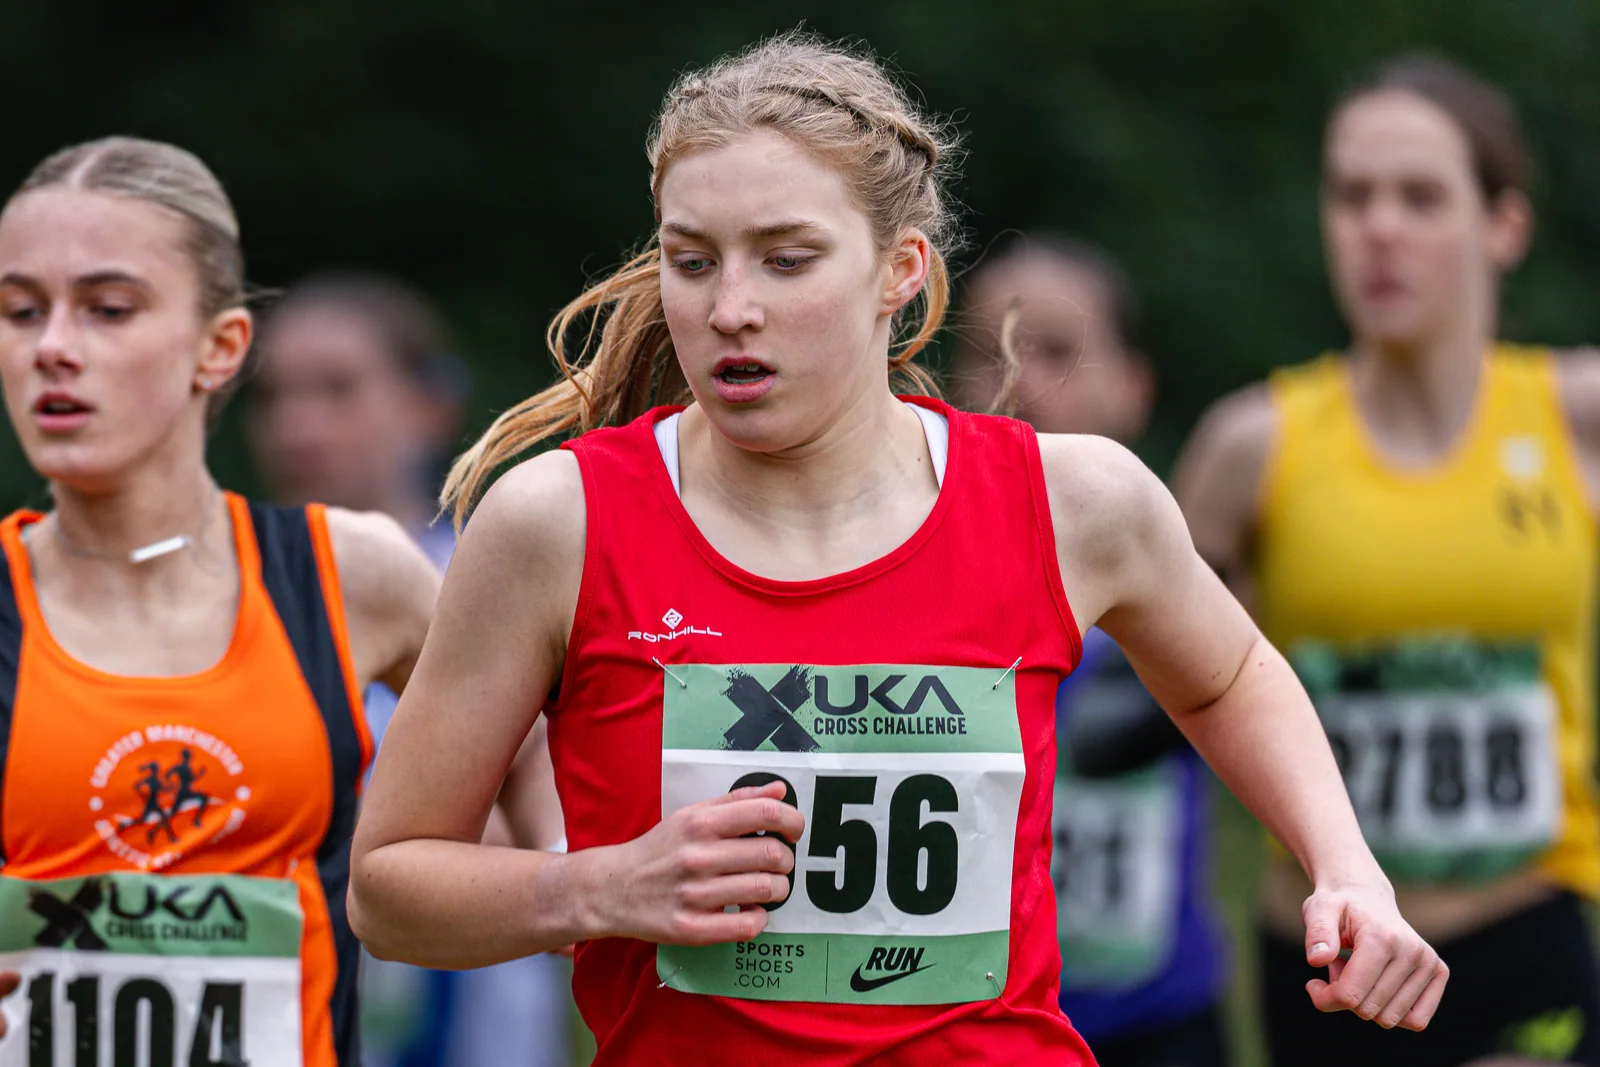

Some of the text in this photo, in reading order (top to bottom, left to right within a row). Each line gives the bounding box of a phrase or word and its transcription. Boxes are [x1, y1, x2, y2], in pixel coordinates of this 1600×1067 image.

[627, 625, 723, 643] RONHILL
[814, 674, 965, 716] UKA
[813, 716, 968, 736] CROSS CHALLENGE
[109, 882, 246, 921] UKA
[105, 920, 248, 943] CROSS CHALLENGE
[736, 940, 805, 958] SPORTS
[864, 946, 926, 972] RUN
[734, 957, 794, 974] SHOES
[733, 974, 780, 990] .COM
[26, 971, 251, 1067] 1104
